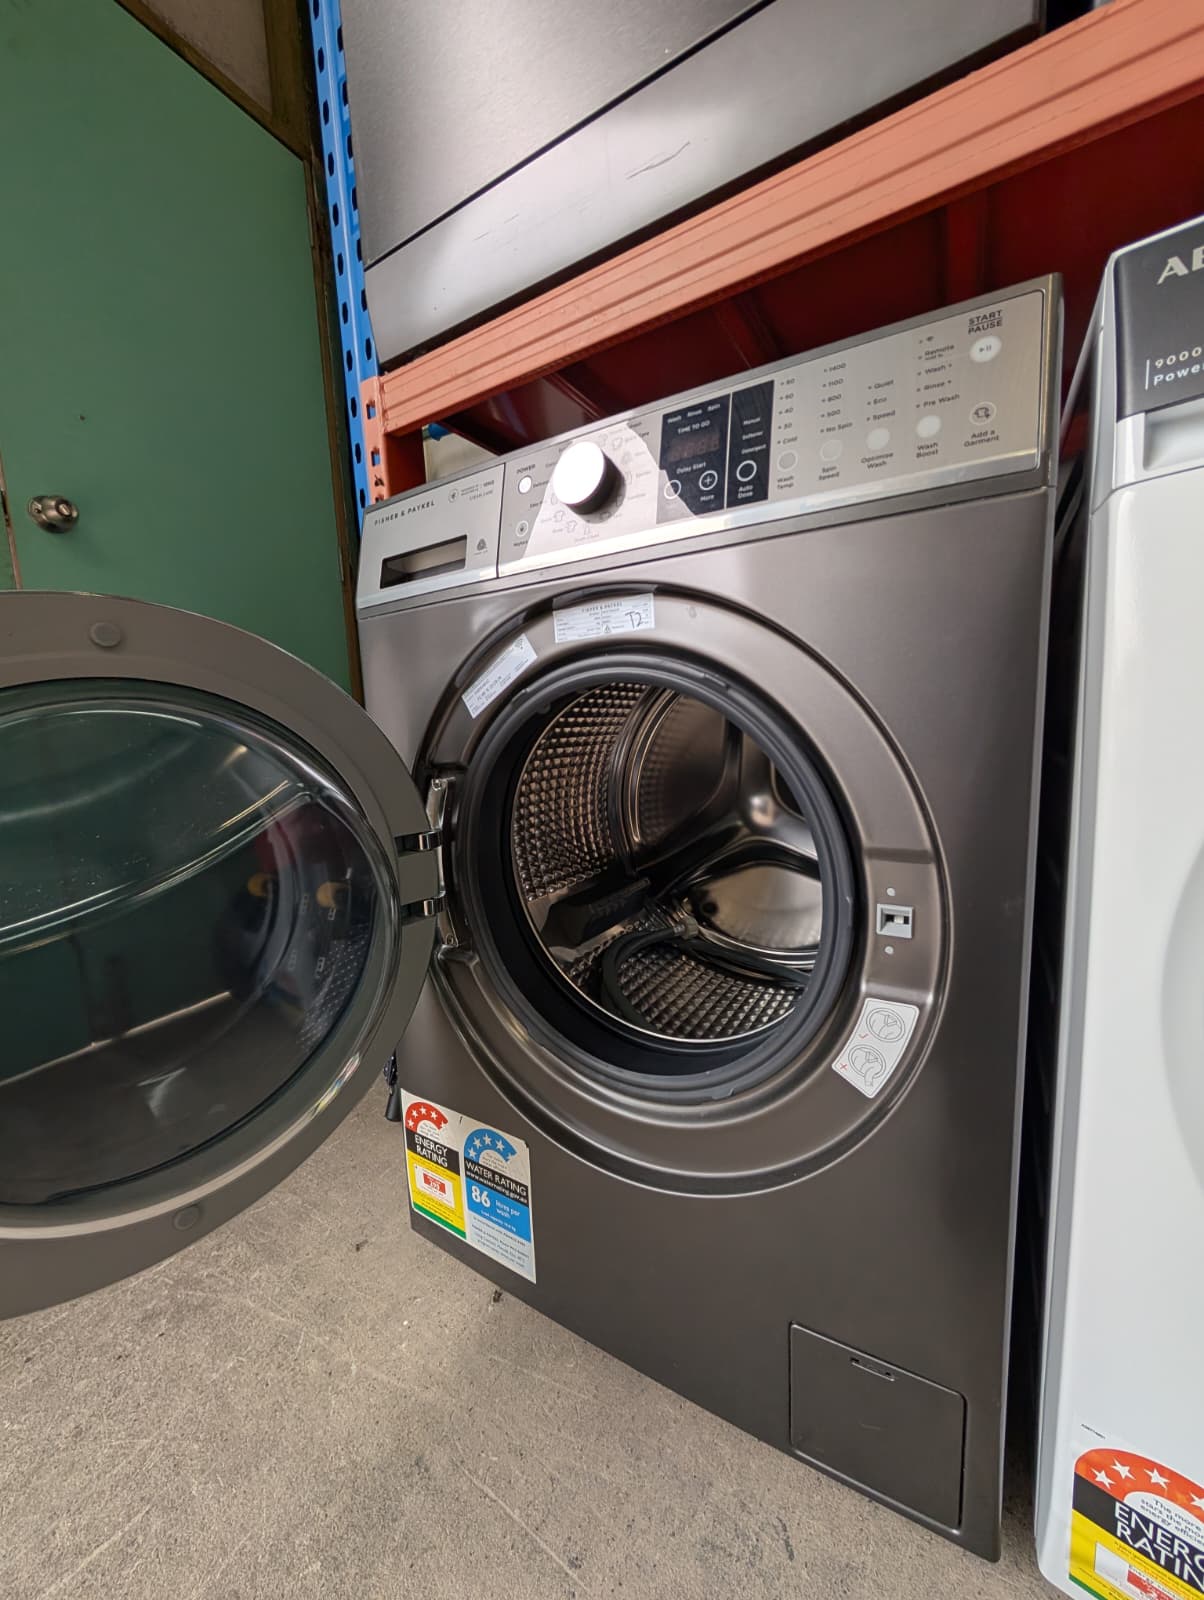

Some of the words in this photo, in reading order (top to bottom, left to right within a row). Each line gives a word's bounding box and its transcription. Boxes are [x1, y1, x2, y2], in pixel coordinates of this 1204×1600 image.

[968, 310, 1003, 326] START
[968, 320, 1003, 335] PAUSE
[1155, 346, 1202, 369] 9000
[924, 365, 946, 375] Wash
[1154, 362, 1204, 386] Powe
[828, 378, 844, 387] 1100
[874, 379, 894, 389] Quiet
[923, 381, 945, 391] Rinse
[873, 396, 887, 405] Eco
[923, 399, 936, 408] Pre
[938, 393, 960, 403] Wash
[872, 410, 896, 421] Speed
[678, 425, 691, 434] TIME
[701, 420, 711, 428] GO
[838, 422, 853, 431] Spin
[783, 436, 798, 445] Cold
[971, 430, 989, 440] Add
[917, 442, 938, 451] Wash
[963, 435, 1000, 448] Garment
[916, 449, 939, 459] Boost
[517, 464, 536, 475] POWER
[676, 466, 692, 475] Delay
[693, 461, 706, 470] Start
[822, 465, 837, 473] Spin
[867, 460, 887, 470] Wash
[819, 471, 840, 481] Speed
[700, 494, 715, 502] More
[738, 491, 753, 499] Dose
[374, 512, 399, 527] FISHER
[407, 500, 436, 515] PAYKEL
[415, 1133, 448, 1157] ENERGY
[416, 1144, 448, 1168] RATING
[465, 1160, 493, 1180] WATER
[494, 1174, 527, 1196] RATING
[472, 1185, 491, 1208] 86
[510, 1209, 521, 1217] per
[1140, 1505, 1171, 1526] energy
[1141, 1499, 1163, 1514] stars
[1166, 1513, 1182, 1527] the
[1153, 1499, 1171, 1514] The
[1174, 1512, 1201, 1532] more
